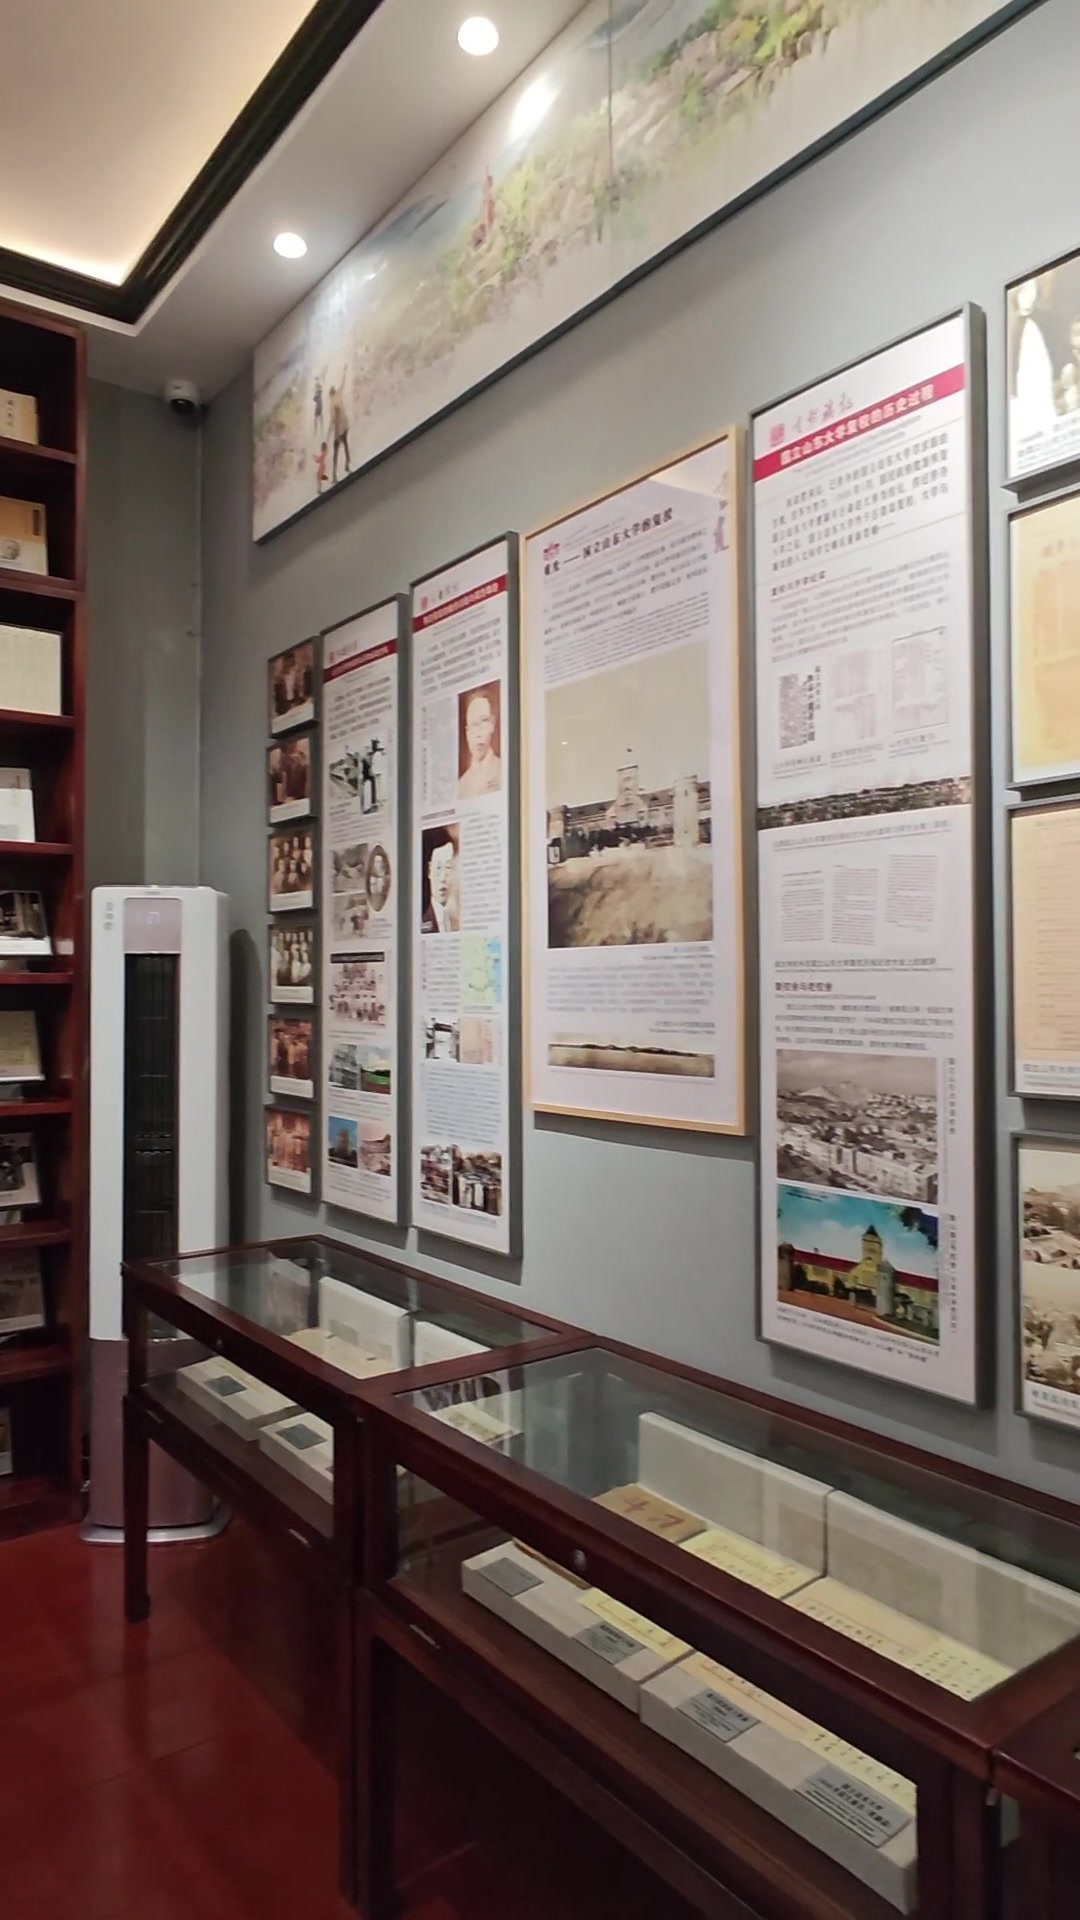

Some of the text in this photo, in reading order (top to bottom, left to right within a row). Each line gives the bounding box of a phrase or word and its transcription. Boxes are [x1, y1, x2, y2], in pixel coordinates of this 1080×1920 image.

[780, 384, 934, 466] 国立山东大学复校的历史过程
